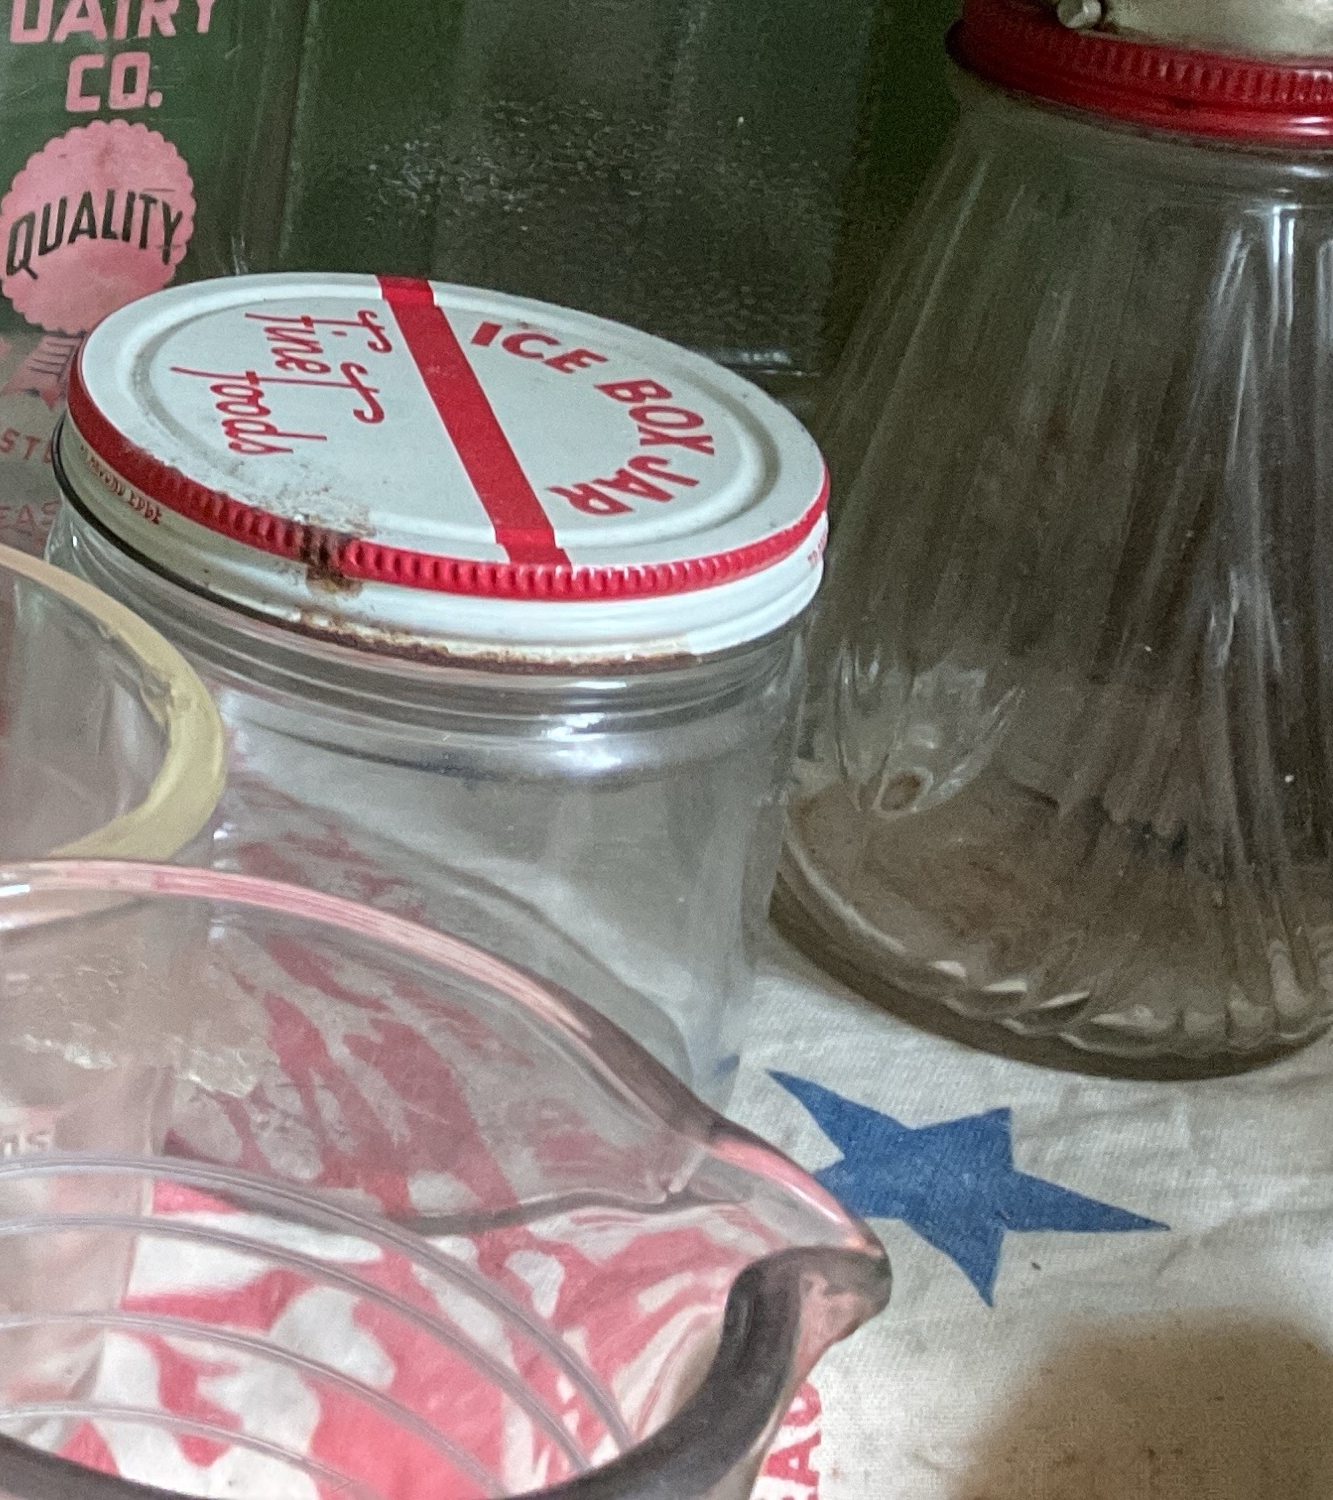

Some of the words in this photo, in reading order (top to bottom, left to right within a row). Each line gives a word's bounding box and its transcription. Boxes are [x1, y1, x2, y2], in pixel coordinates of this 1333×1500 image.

[65, 52, 165, 113] CO.
[3, 189, 185, 280] QUALITY
[470, 320, 610, 374] ICE
[593, 378, 716, 457] BOX
[544, 455, 700, 516] JAR
